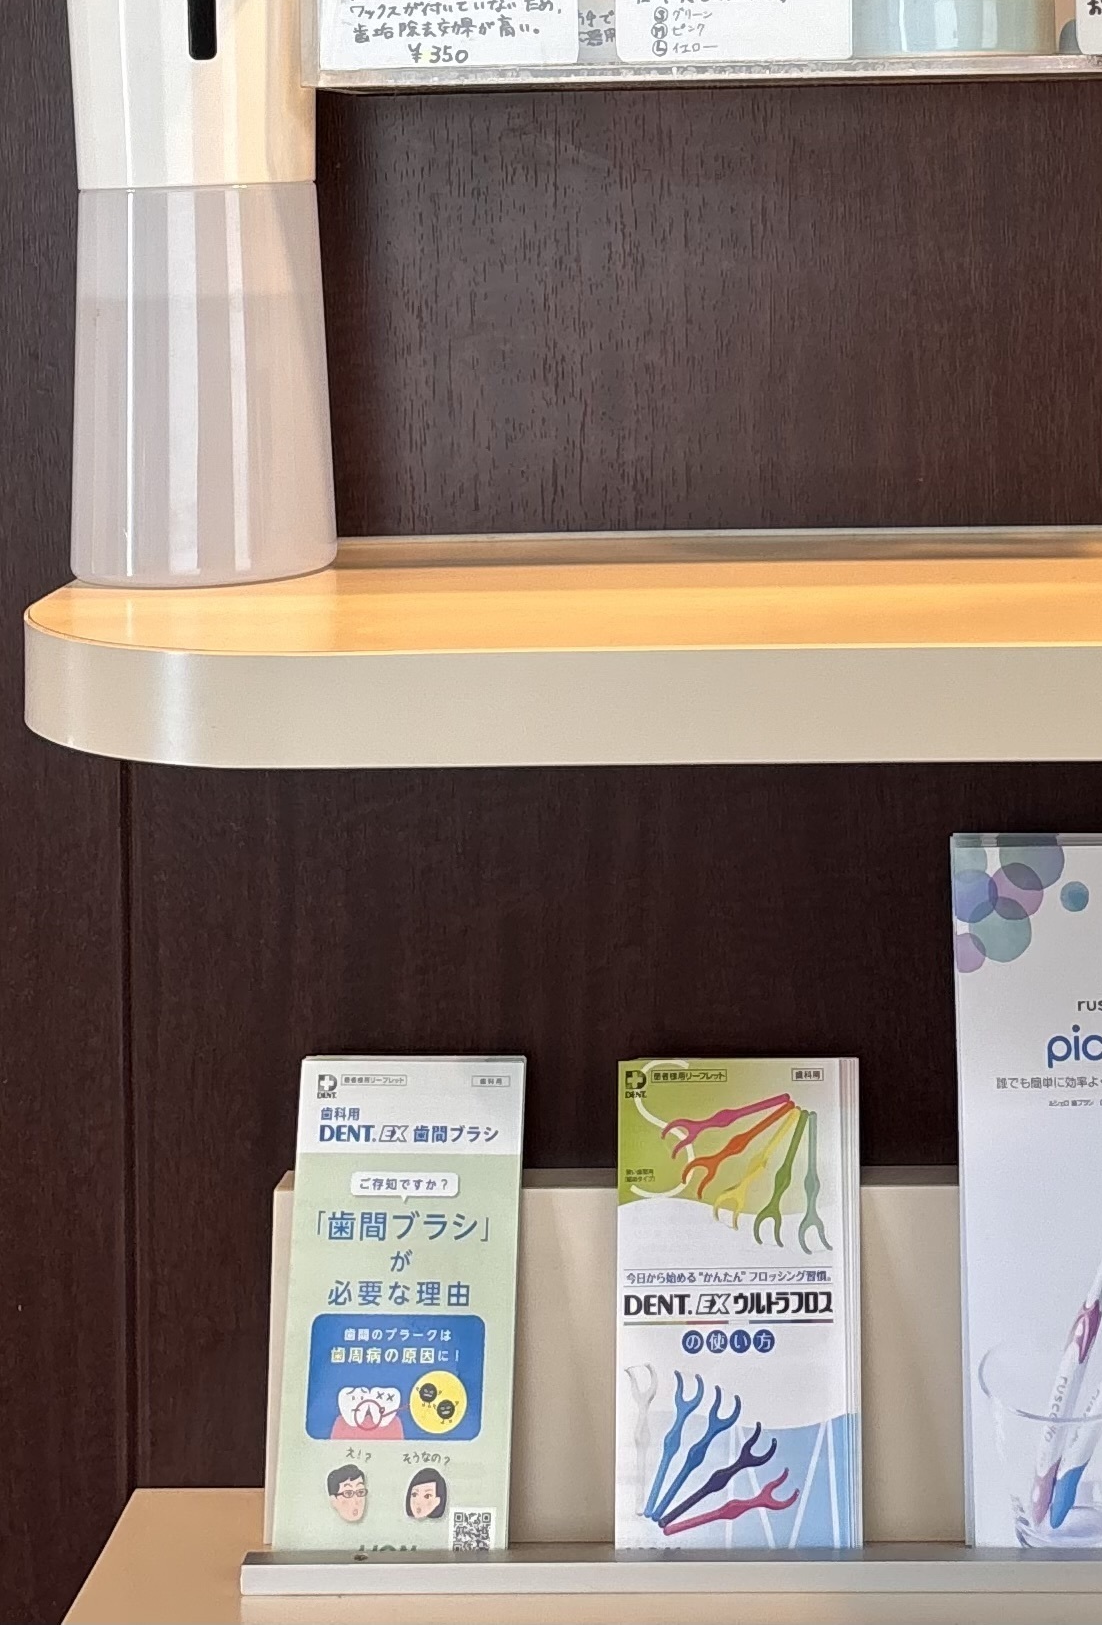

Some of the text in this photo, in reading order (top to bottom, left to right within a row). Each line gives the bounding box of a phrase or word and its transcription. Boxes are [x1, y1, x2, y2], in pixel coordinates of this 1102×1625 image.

[408, 42, 469, 64] ¥350
[320, 1107, 361, 1122] 歯科用
[413, 1125, 499, 1144] 歯間ブラシ
[317, 1210, 490, 1242] 「歯間ブラシ」
[389, 1248, 413, 1273] が
[327, 1279, 471, 1307] 必要な理由
[733, 1291, 834, 1315] ウルトラフロス
[684, 1331, 774, 1353] の使い方
